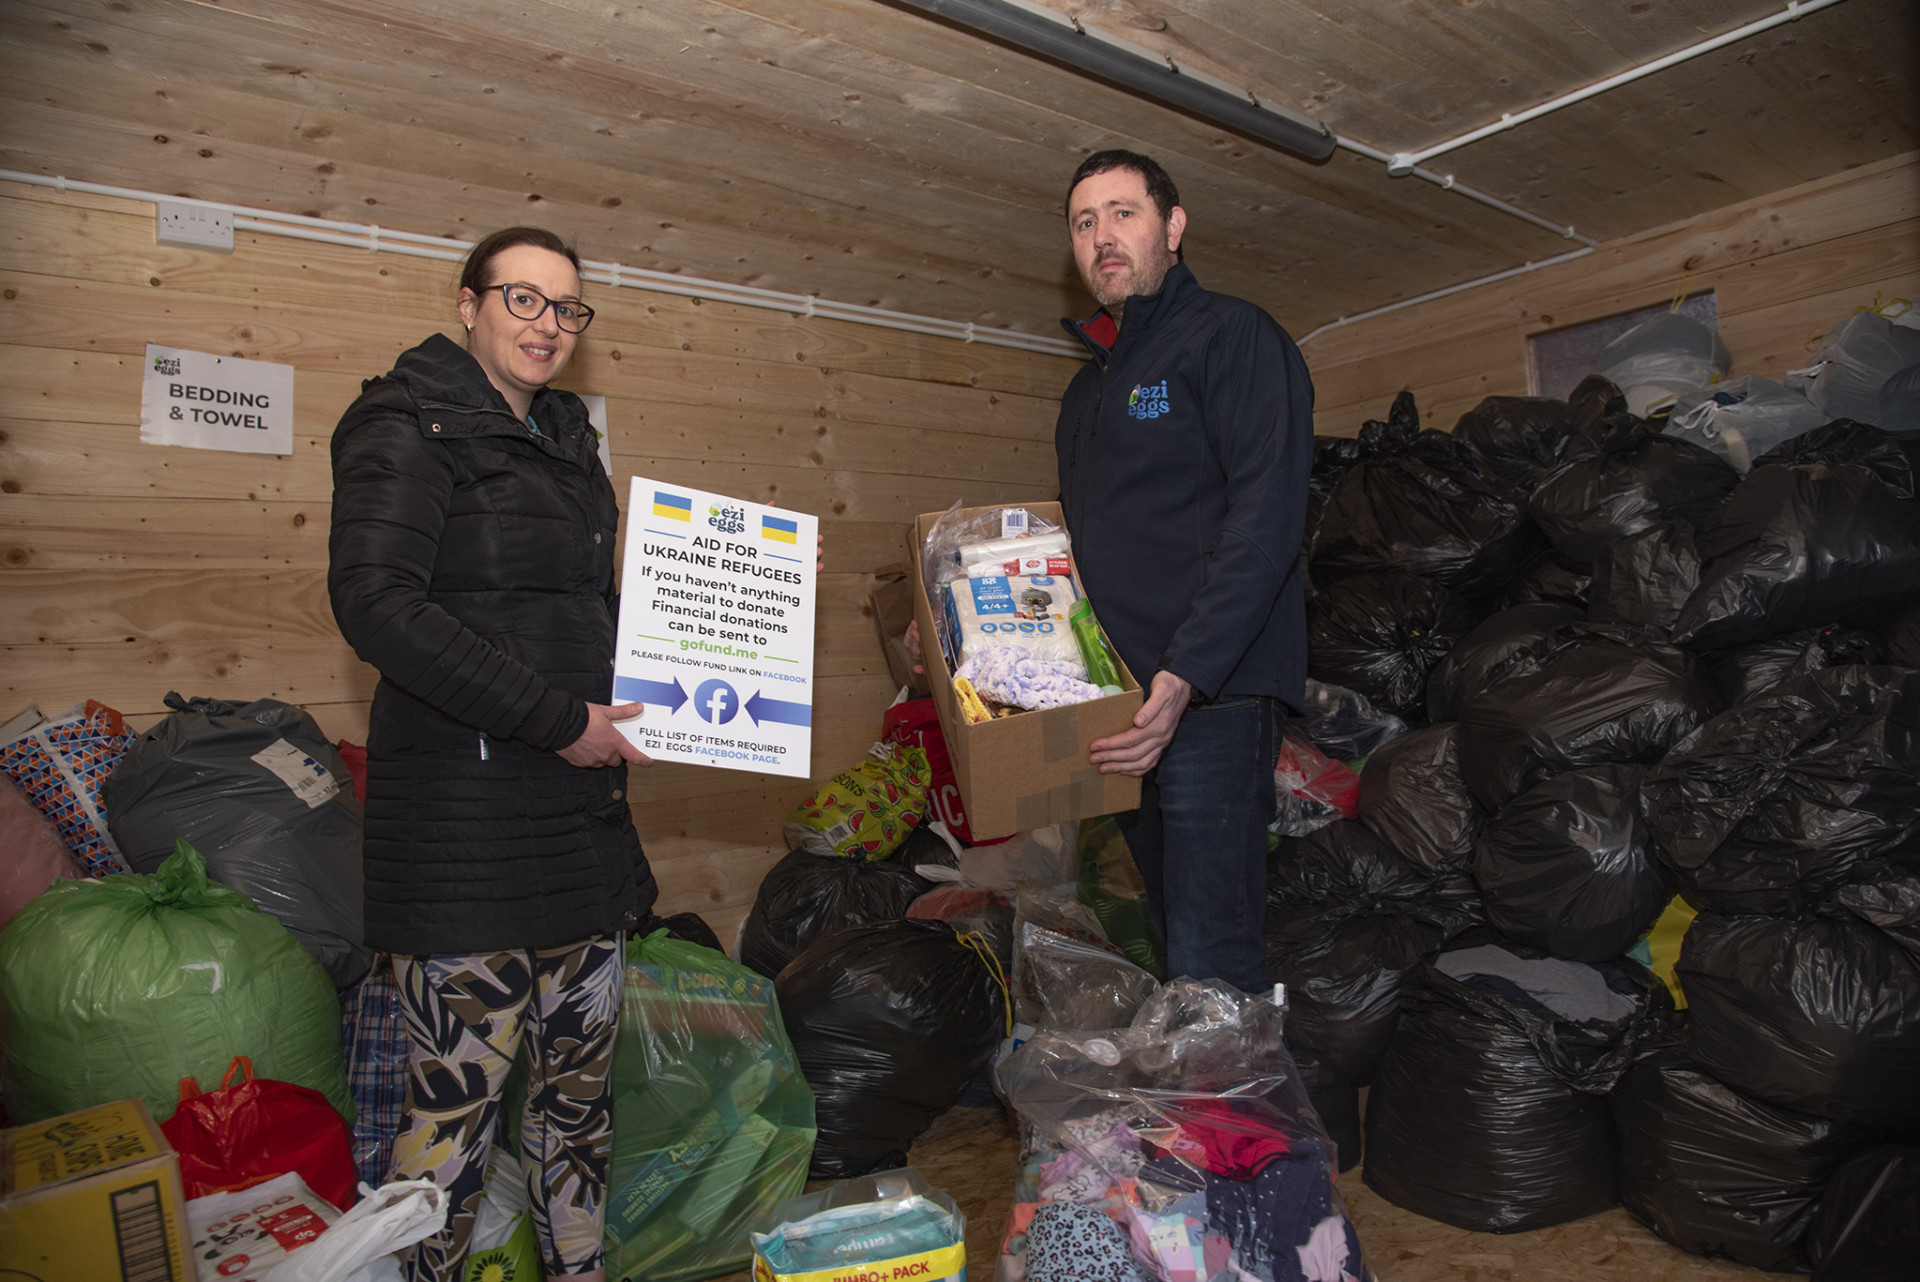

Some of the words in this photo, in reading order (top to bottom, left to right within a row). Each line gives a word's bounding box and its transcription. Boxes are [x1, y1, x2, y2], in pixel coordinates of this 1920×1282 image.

[154, 364, 181, 376] eggs
[164, 358, 180, 367] ezi
[169, 383, 269, 408] BEDDING
[1140, 380, 1168, 399] ezi
[169, 406, 183, 420] &
[190, 408, 269, 430] TOWEL
[1128, 399, 1169, 419] eggs
[708, 516, 745, 534] eggs
[721, 507, 745, 522] ezi
[692, 536, 721, 551] AID
[726, 542, 758, 558] FOR
[643, 543, 716, 568] UKRAINE
[721, 559, 801, 585] REFUGEES
[641, 566, 654, 577] If
[655, 569, 681, 585] you
[685, 573, 737, 593] haven't
[740, 585, 800, 607] anything
[657, 585, 715, 605] material
[720, 596, 734, 608] to
[737, 599, 785, 618] donate
[652, 601, 716, 620] Financial
[720, 611, 788, 633] donations
[668, 621, 693, 634] can
[698, 624, 715, 637] be
[719, 628, 750, 643] sent
[753, 633, 767, 646] to
[679, 638, 758, 660] gofund.me
[631, 650, 663, 661] PLEASE
[665, 655, 702, 667] FOLLOW
[703, 661, 727, 671] FUND
[729, 666, 747, 674] LINK
[749, 669, 762, 677] ON
[763, 671, 807, 684] FACEBOOK
[639, 727, 664, 738] FULL
[667, 731, 687, 742] LIST
[689, 735, 703, 743] OF
[705, 736, 735, 748] ITEMS
[737, 740, 786, 754] REQUIRED
[645, 740, 661, 749] EZI
[666, 743, 693, 753] EGGS
[695, 746, 750, 761] FACEBOOK
[752, 754, 780, 765] PAGE.
[832, 773, 865, 797] SONS
[893, 1261, 930, 1280] PACK
